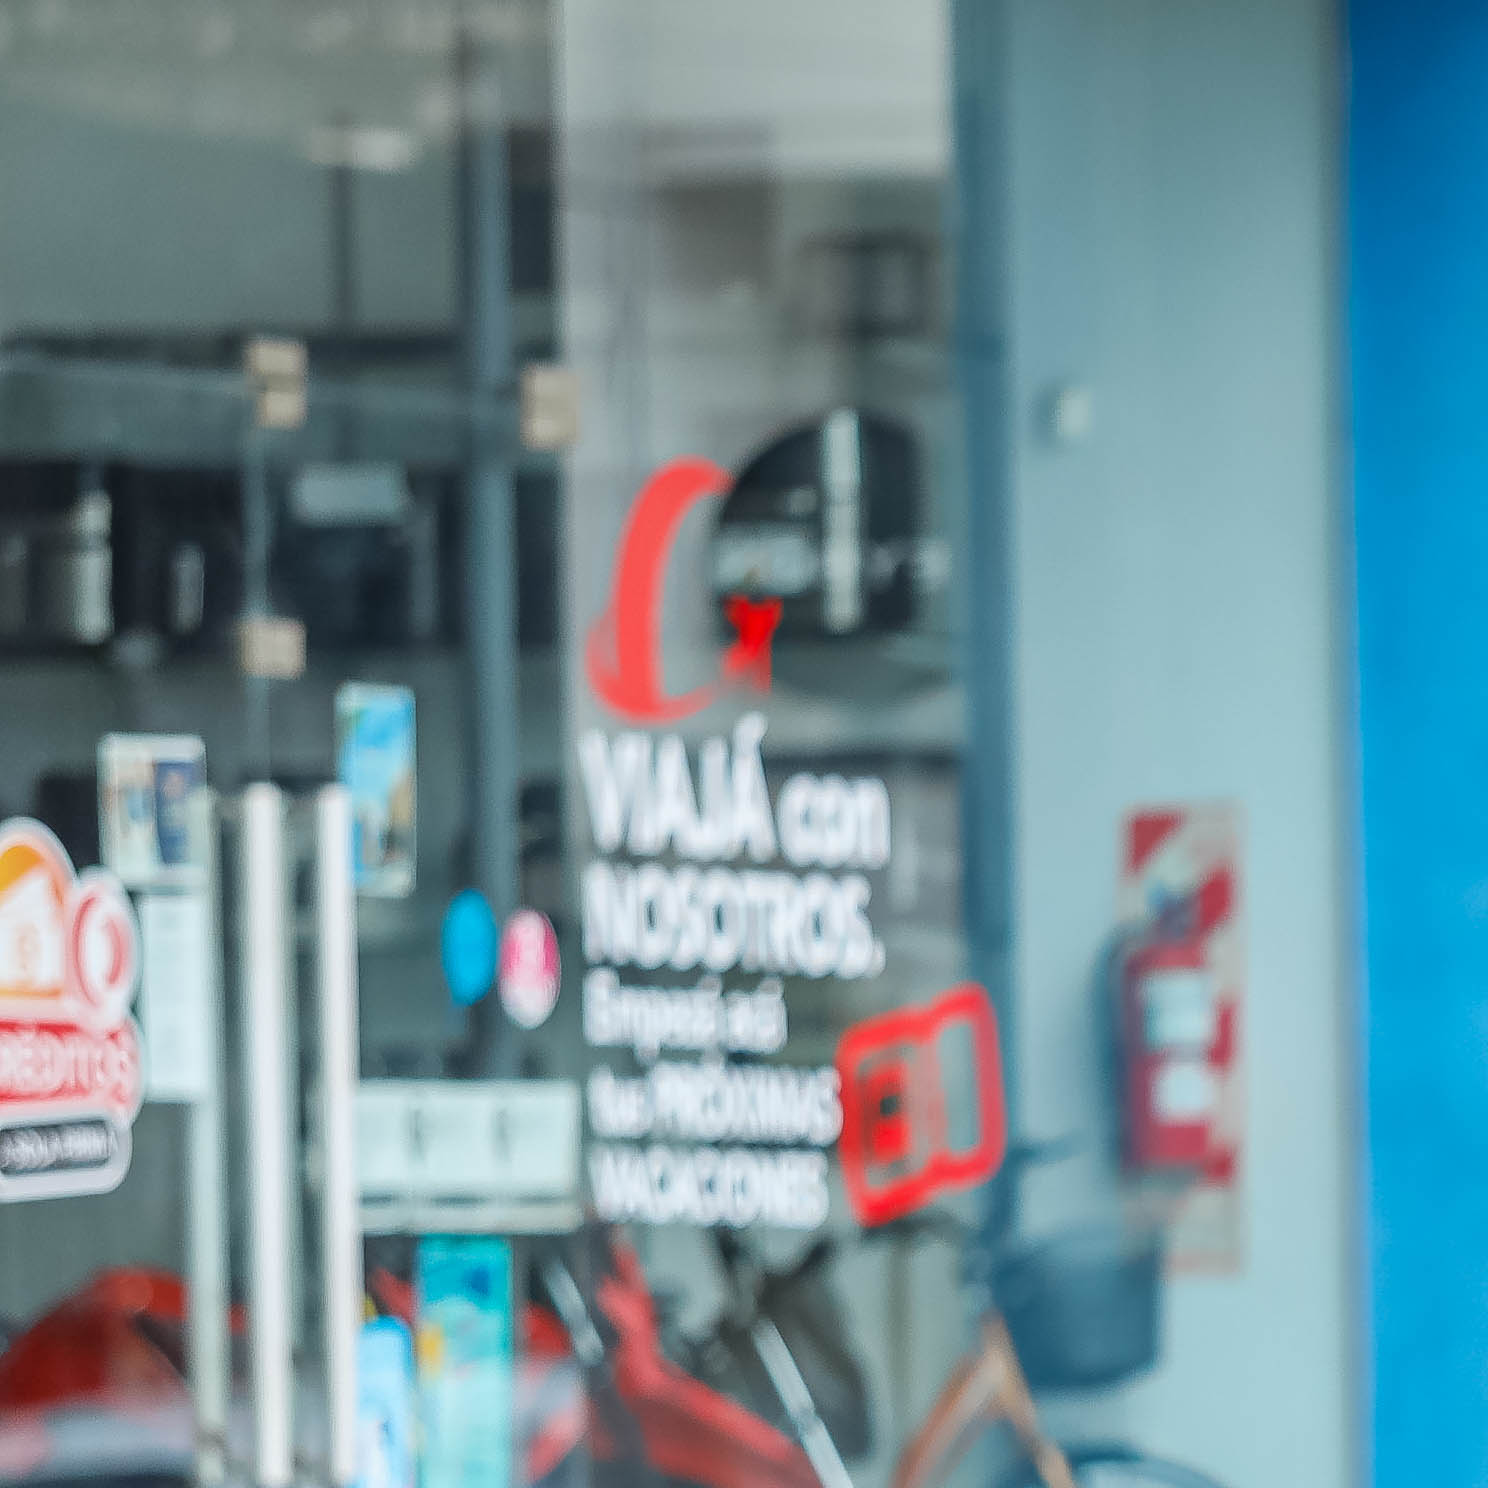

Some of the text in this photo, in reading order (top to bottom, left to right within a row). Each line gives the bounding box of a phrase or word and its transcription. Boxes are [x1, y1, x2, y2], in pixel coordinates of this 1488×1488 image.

[579, 711, 891, 870] VIAJÁ con
[582, 862, 886, 980] NOSOTROS.
[588, 1146, 830, 1232] VACACIONES
